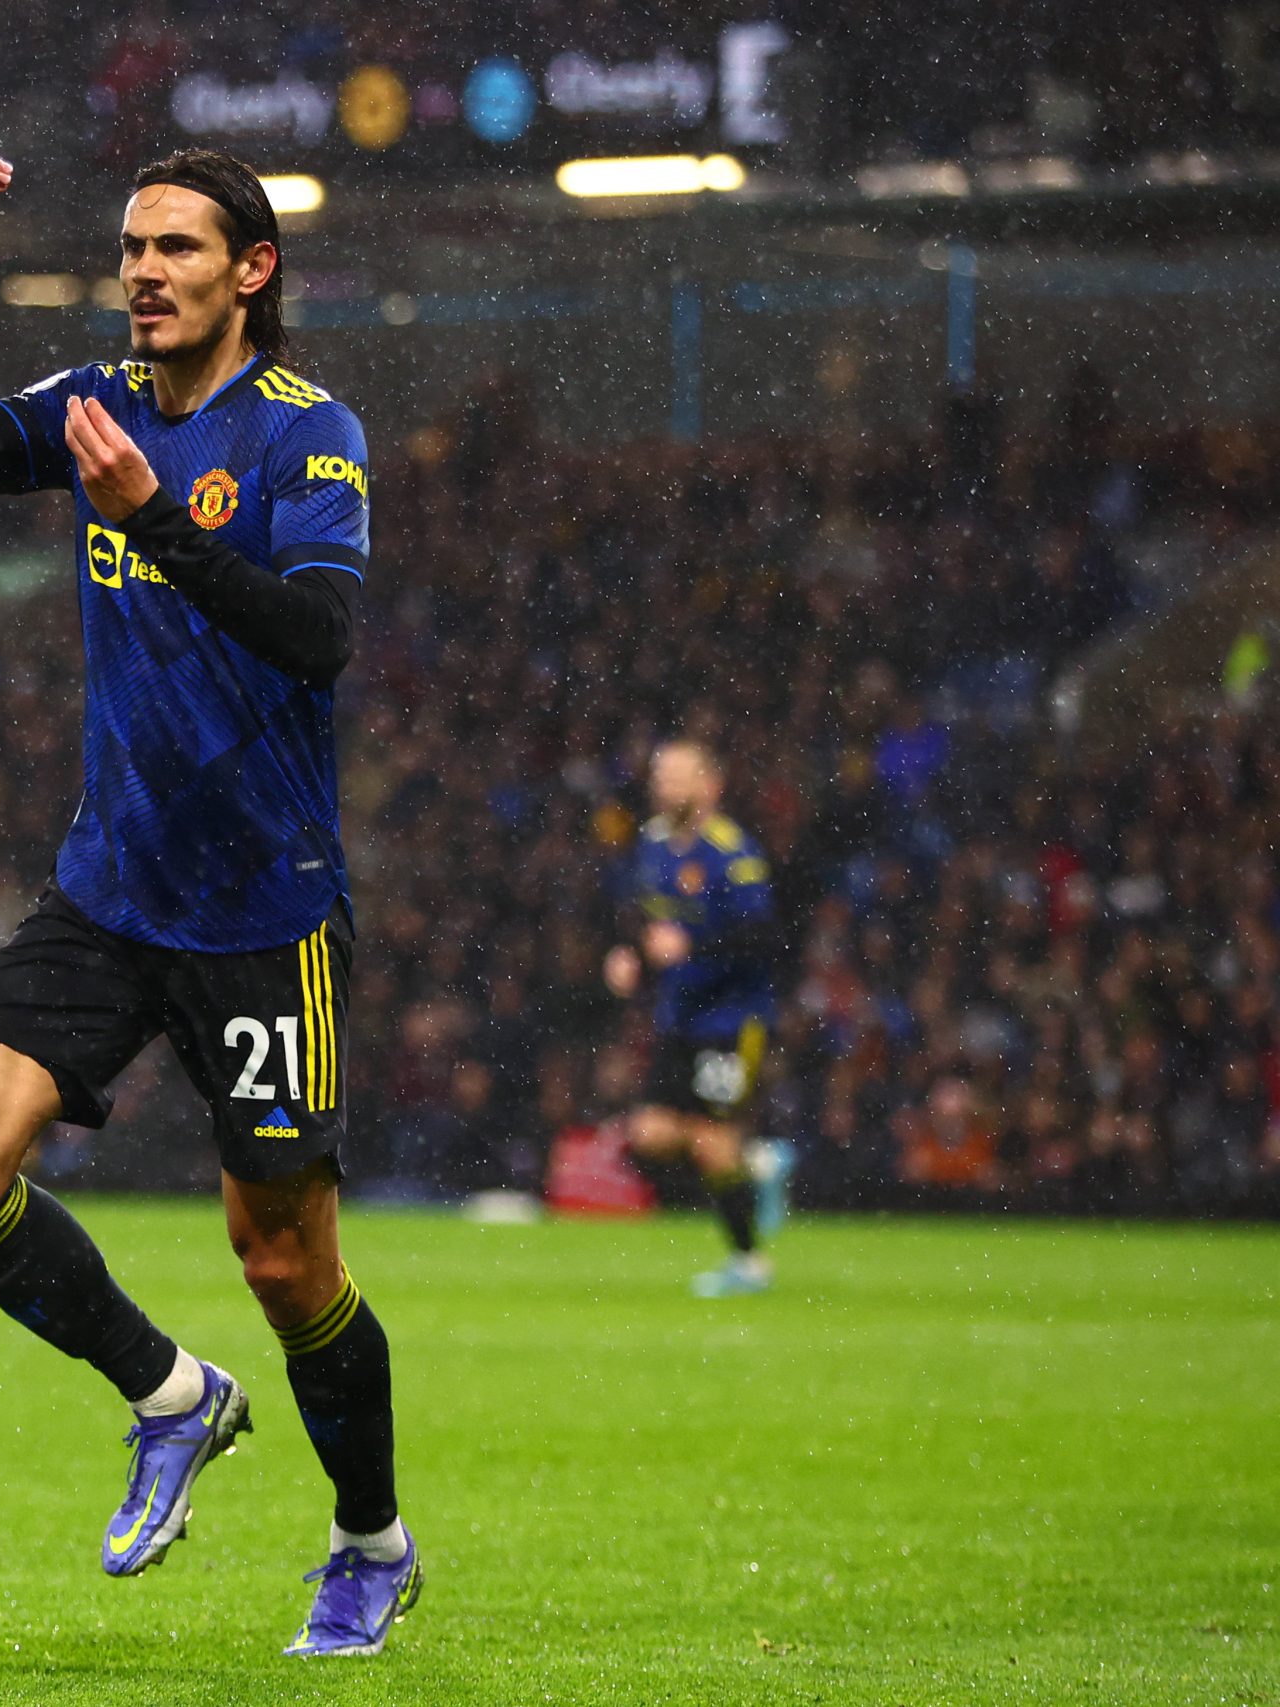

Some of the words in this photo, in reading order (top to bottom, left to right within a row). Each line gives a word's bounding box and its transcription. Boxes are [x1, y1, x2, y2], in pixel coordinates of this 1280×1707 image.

[196, 472, 235, 494] MANCHESTER
[195, 513, 225, 526] UNITED
[223, 1015, 302, 1101] 21
[253, 1125, 300, 1139] adidas
